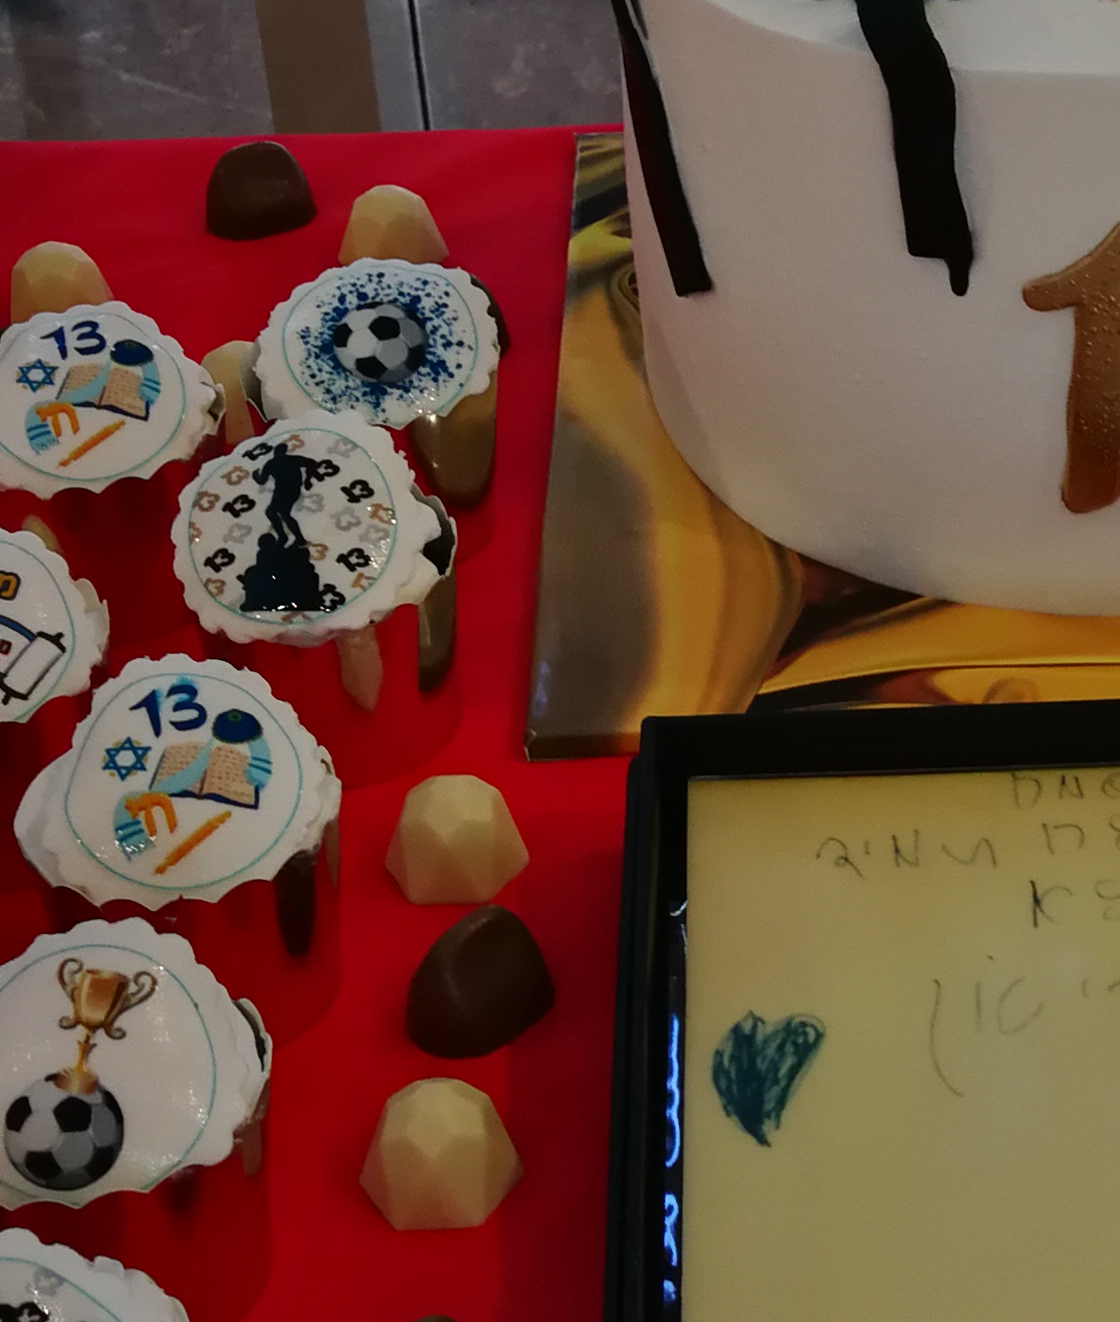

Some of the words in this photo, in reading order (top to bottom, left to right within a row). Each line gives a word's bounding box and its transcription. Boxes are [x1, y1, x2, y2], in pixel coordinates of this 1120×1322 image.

[40, 320, 107, 360] 13
[341, 479, 375, 503] 13
[222, 494, 256, 518] 13
[204, 548, 236, 573] 13
[336, 548, 371, 572] 13
[129, 684, 208, 738] 13
